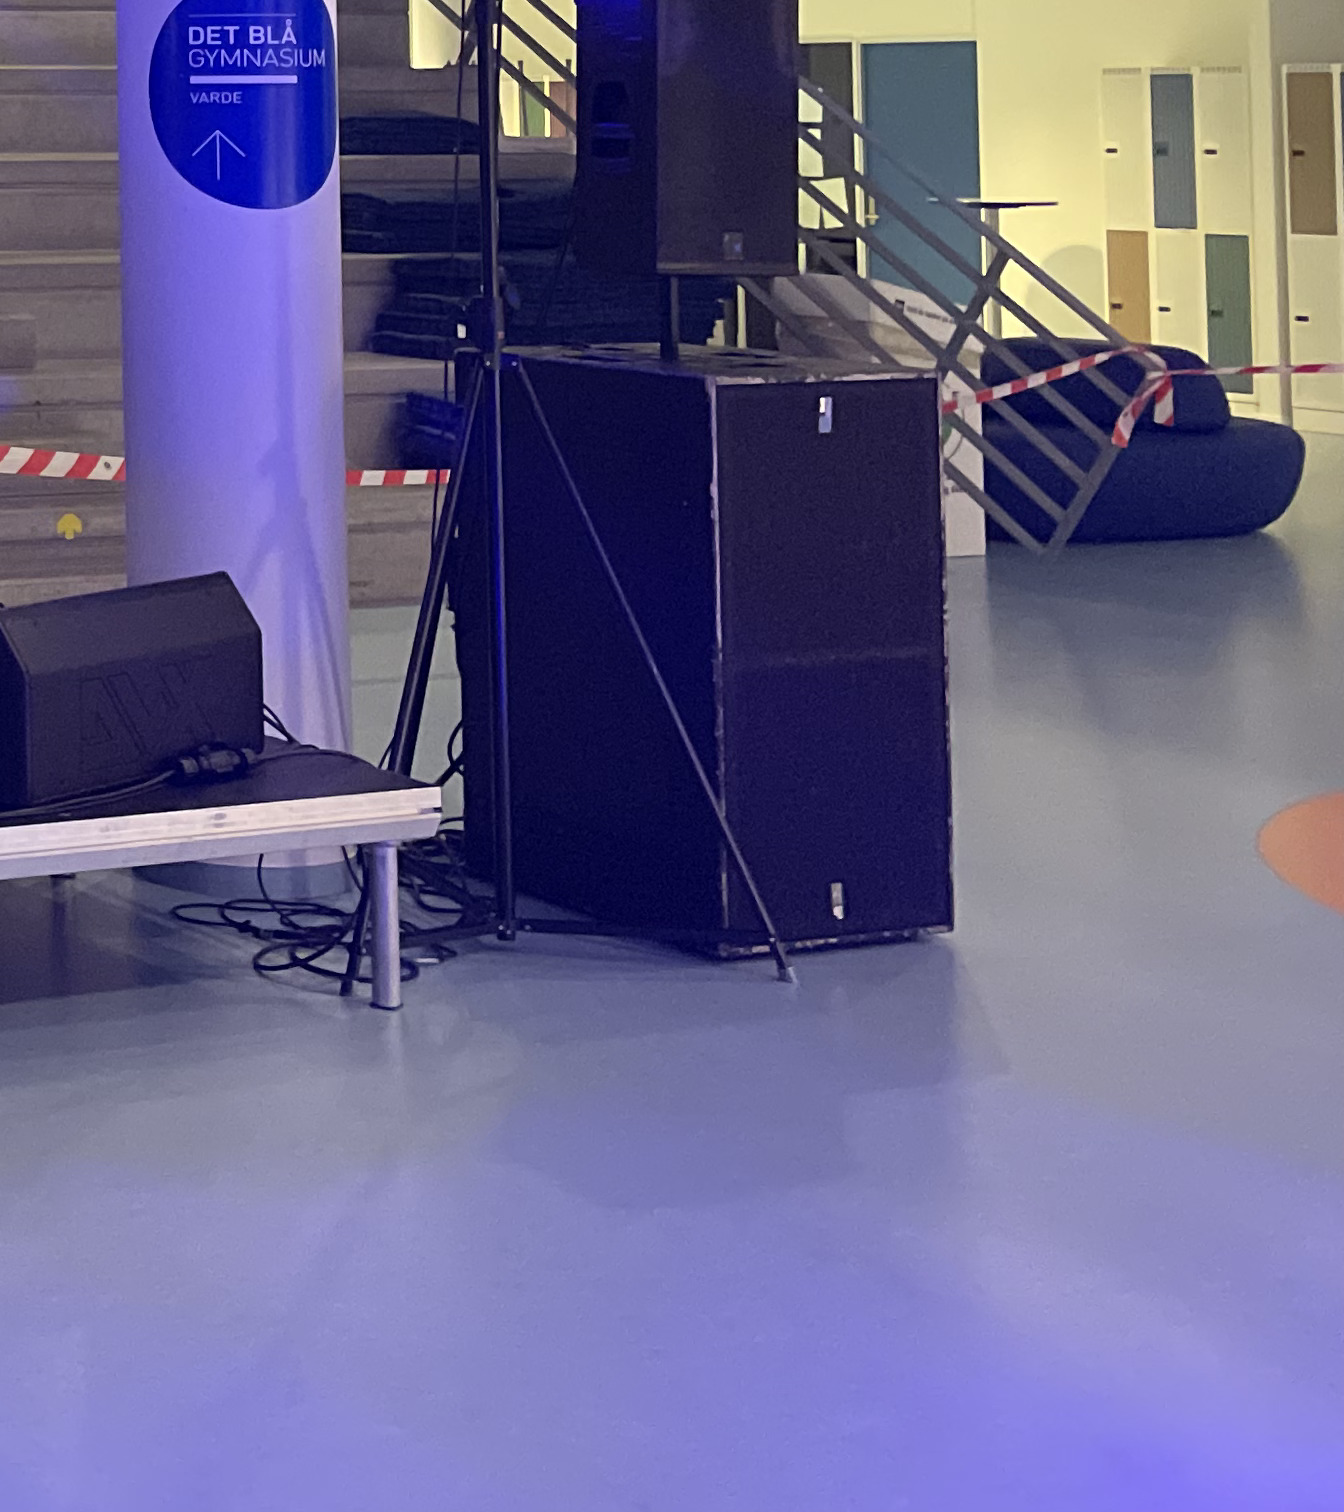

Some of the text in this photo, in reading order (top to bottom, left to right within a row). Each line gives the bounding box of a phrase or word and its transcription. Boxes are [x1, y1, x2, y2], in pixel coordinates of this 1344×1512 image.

[188, 18, 297, 45] DET BLÅ
[188, 47, 326, 69] GYMNASIUM
[190, 91, 243, 104] VARDE
